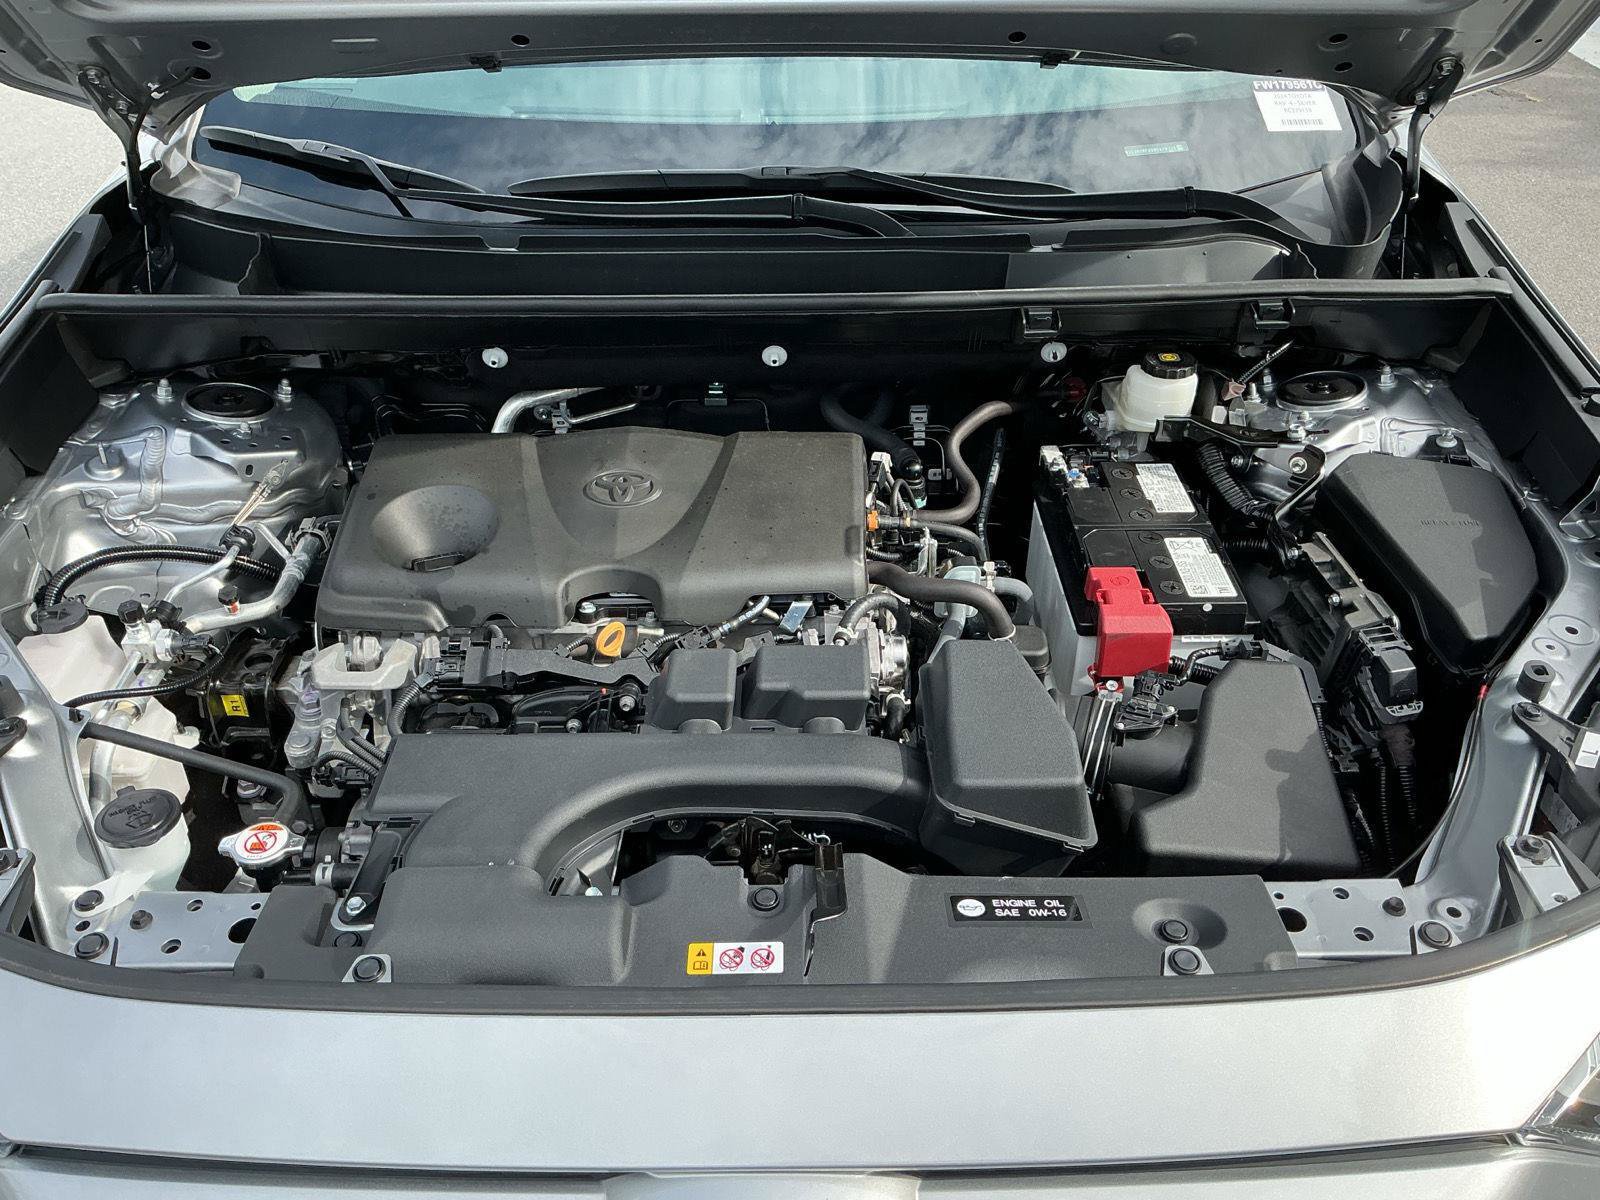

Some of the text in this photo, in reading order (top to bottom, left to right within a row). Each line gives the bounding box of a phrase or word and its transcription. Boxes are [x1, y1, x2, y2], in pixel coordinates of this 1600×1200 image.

[992, 899, 1065, 907] ENGINE OIL
[995, 908, 1067, 917] SAE 0W-16
